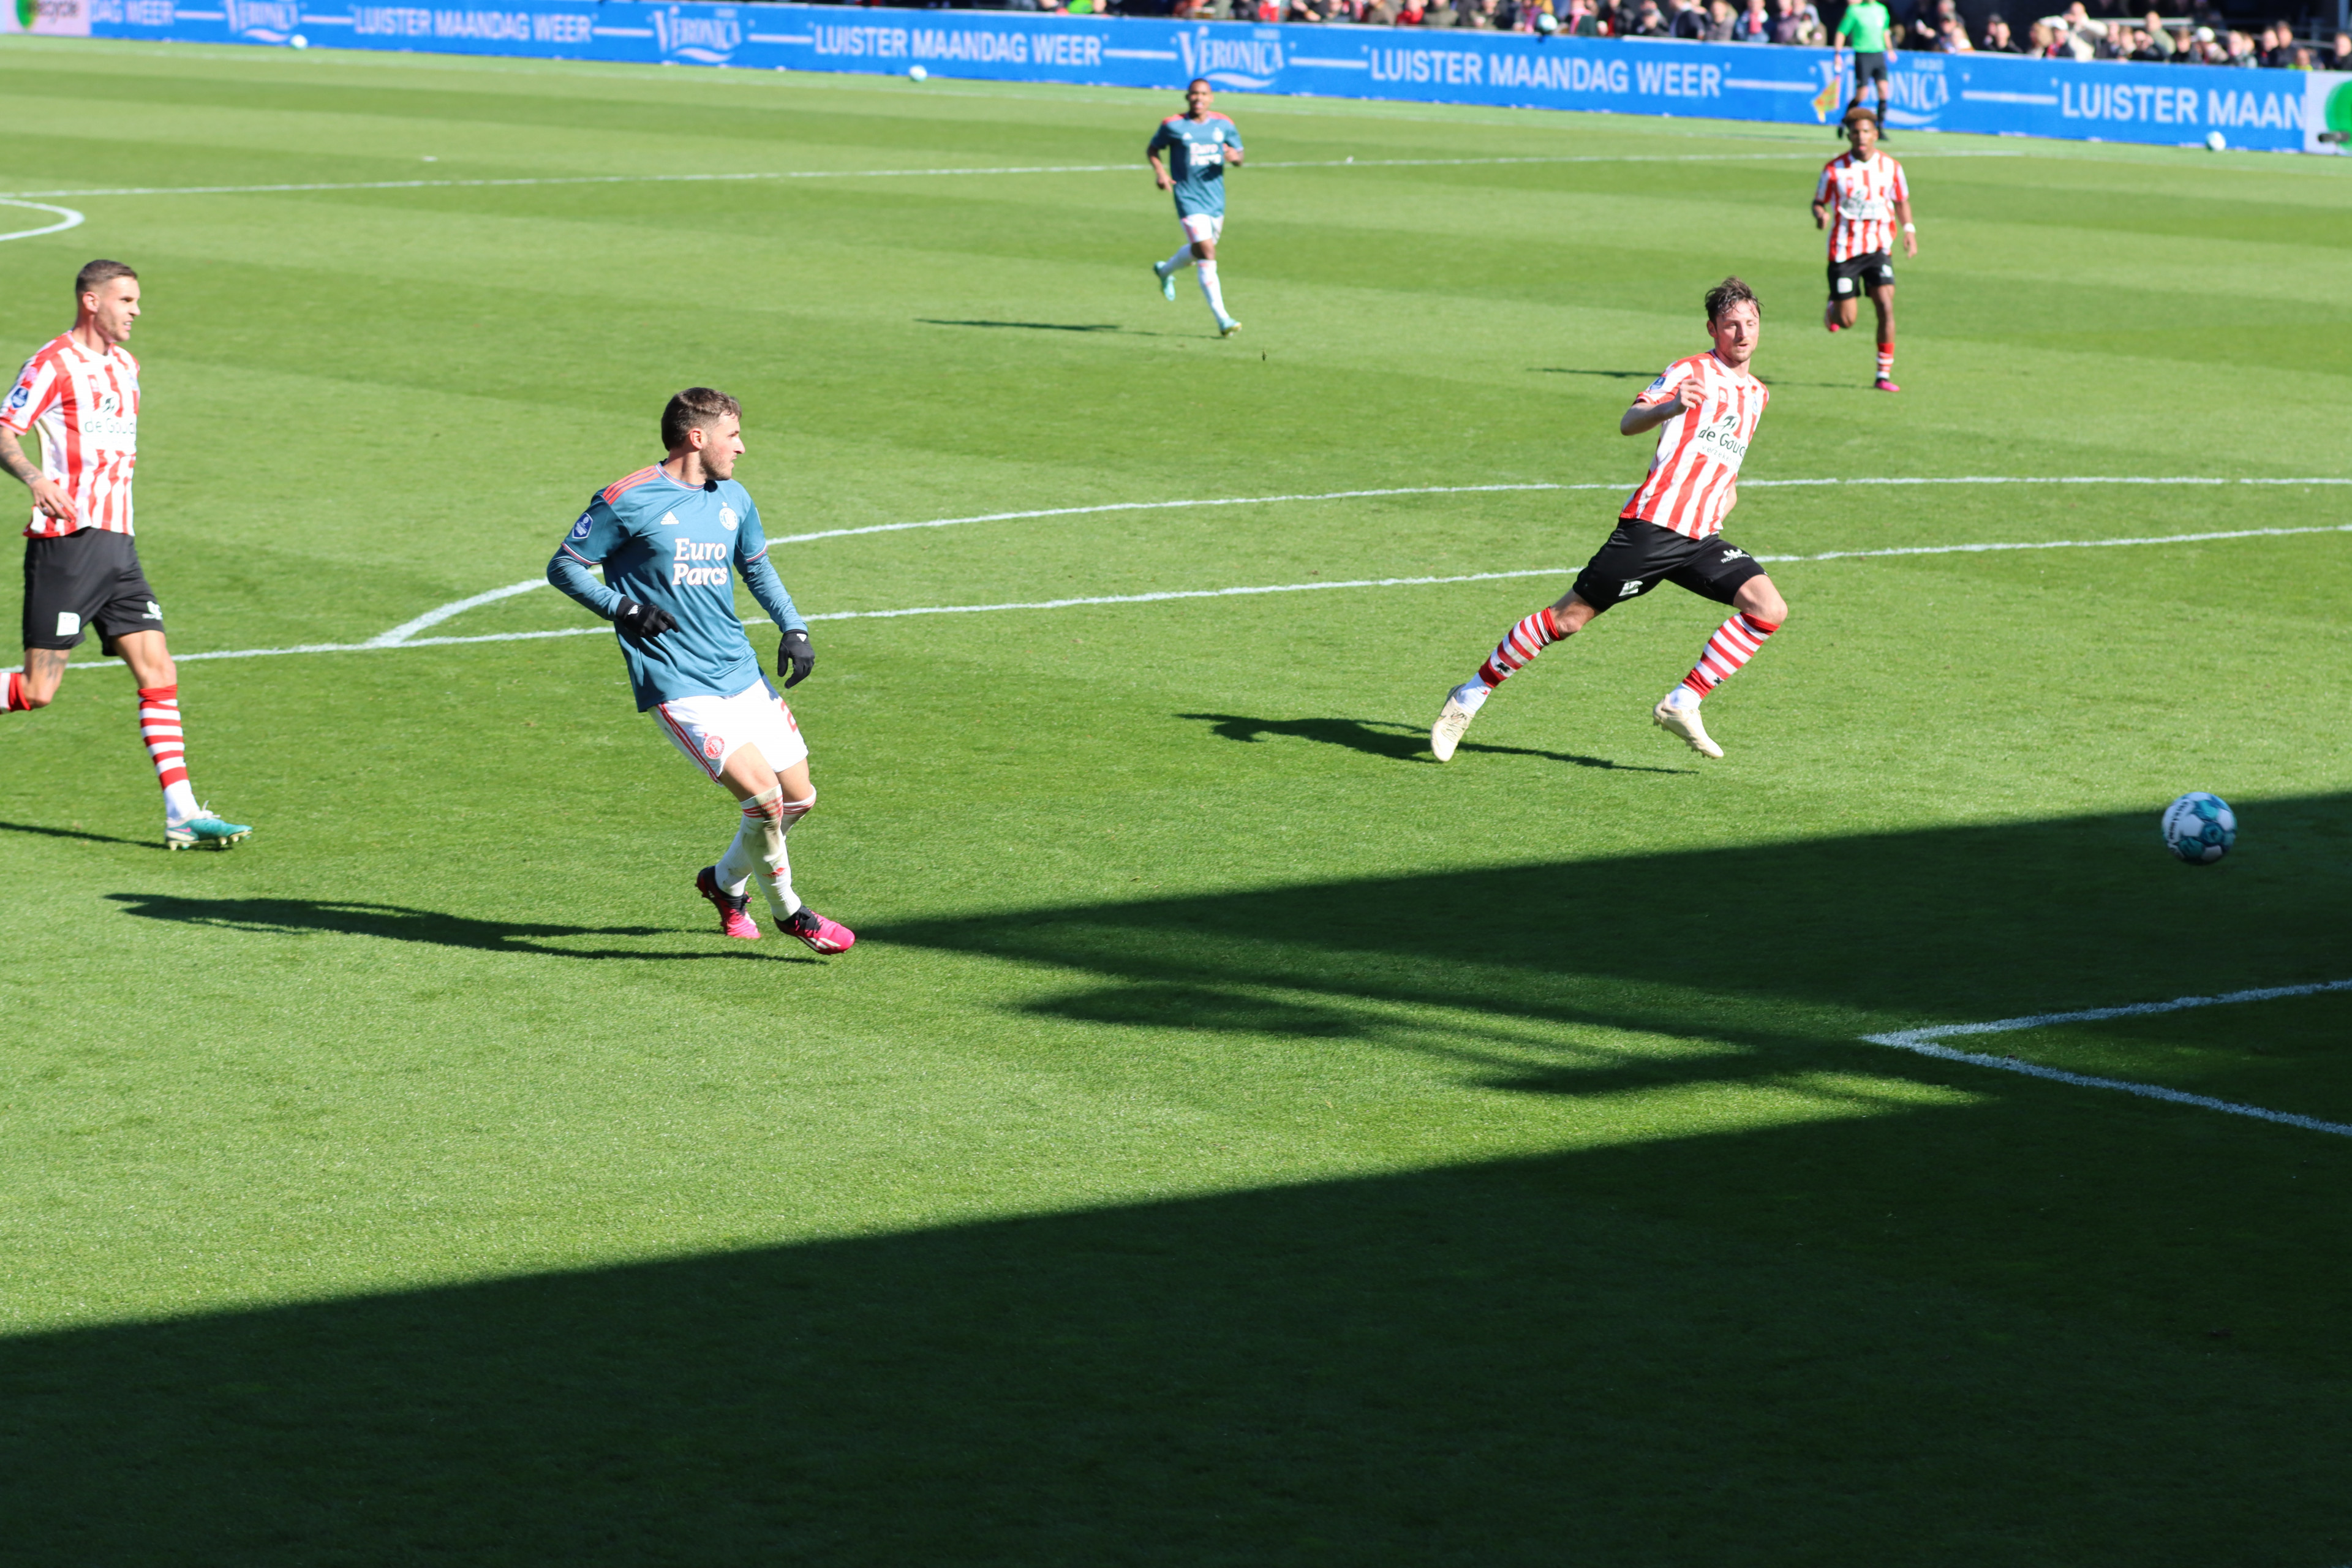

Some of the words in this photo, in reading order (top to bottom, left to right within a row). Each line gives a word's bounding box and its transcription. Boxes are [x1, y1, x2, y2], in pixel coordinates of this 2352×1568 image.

[1489, 54, 1629, 92] MAANDAG
[1698, 426, 1716, 442] de
[674, 538, 726, 560] Euro
[672, 563, 728, 586] Parcs
